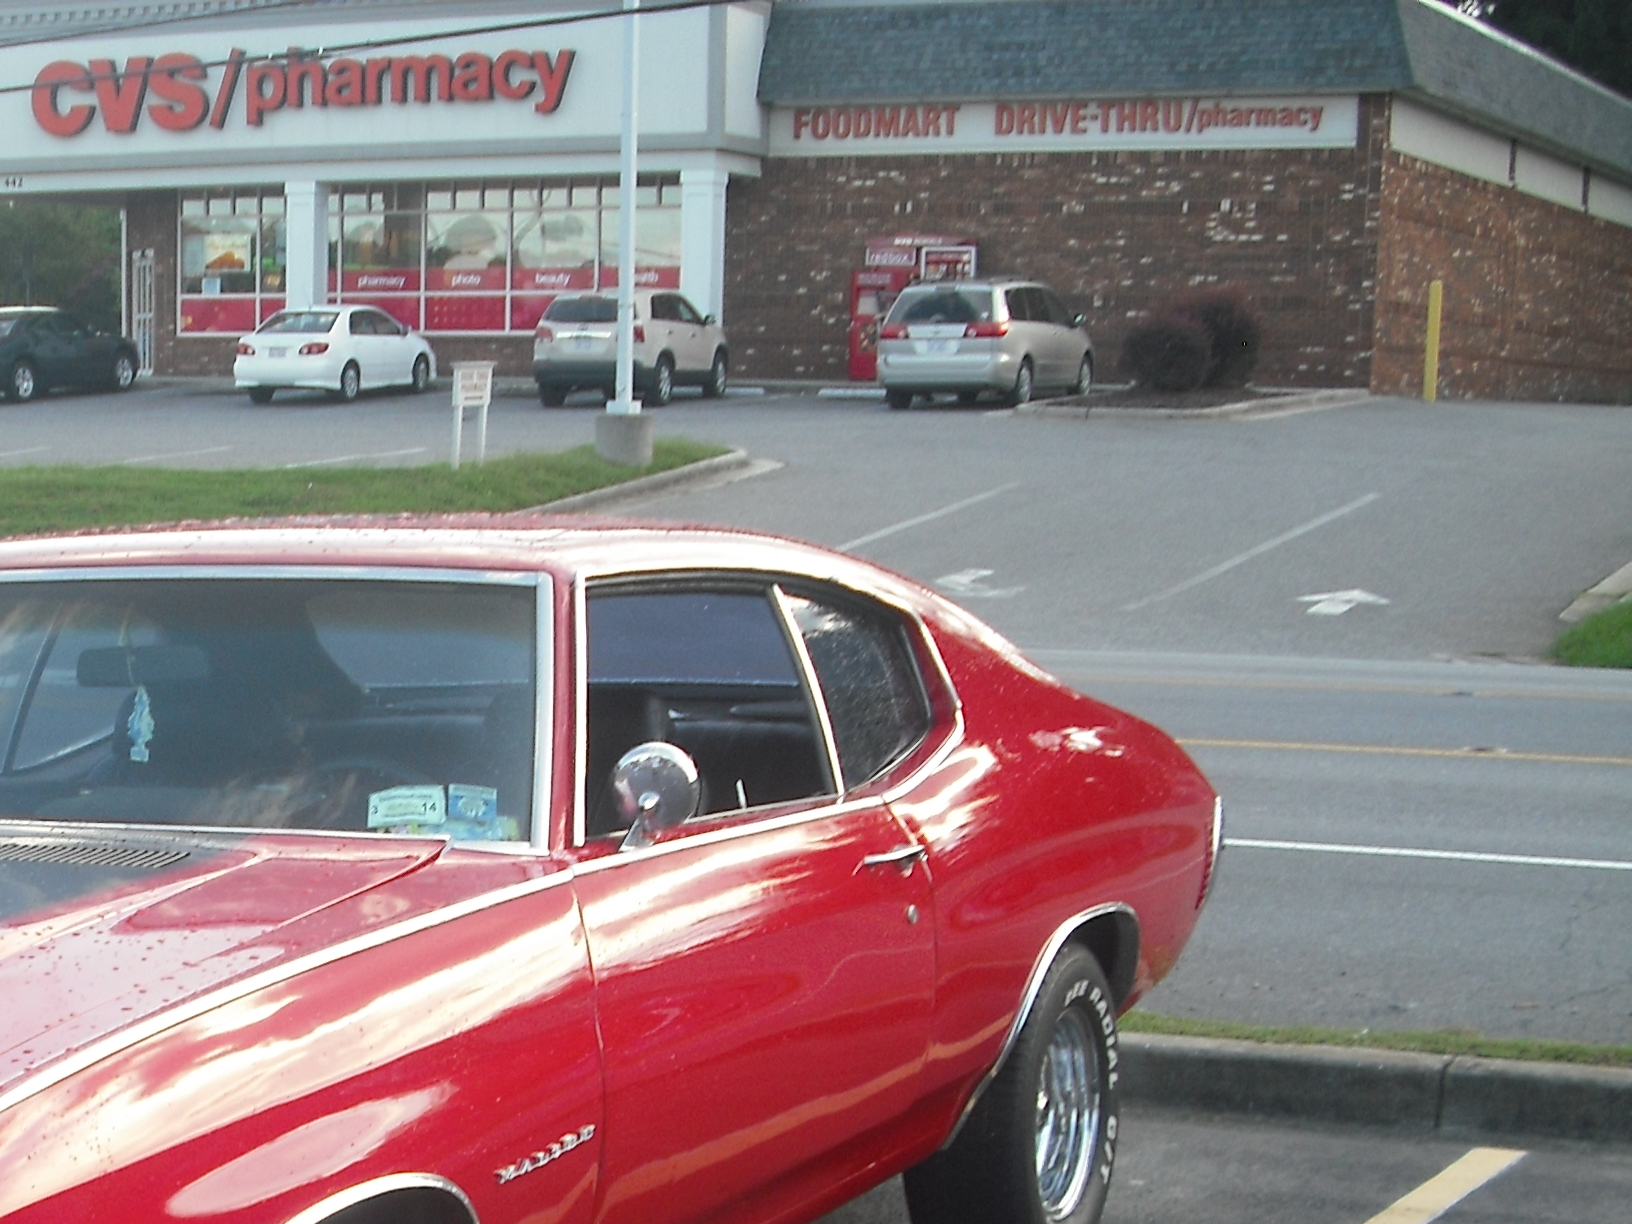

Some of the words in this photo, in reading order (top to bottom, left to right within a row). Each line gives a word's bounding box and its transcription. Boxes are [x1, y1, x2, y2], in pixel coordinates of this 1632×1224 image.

[31, 47, 576, 138] CVS/pharmacy
[793, 104, 961, 140] FOODMART
[358, 274, 406, 288] pharmacy
[451, 273, 481, 287] photo
[535, 272, 571, 287] beauty
